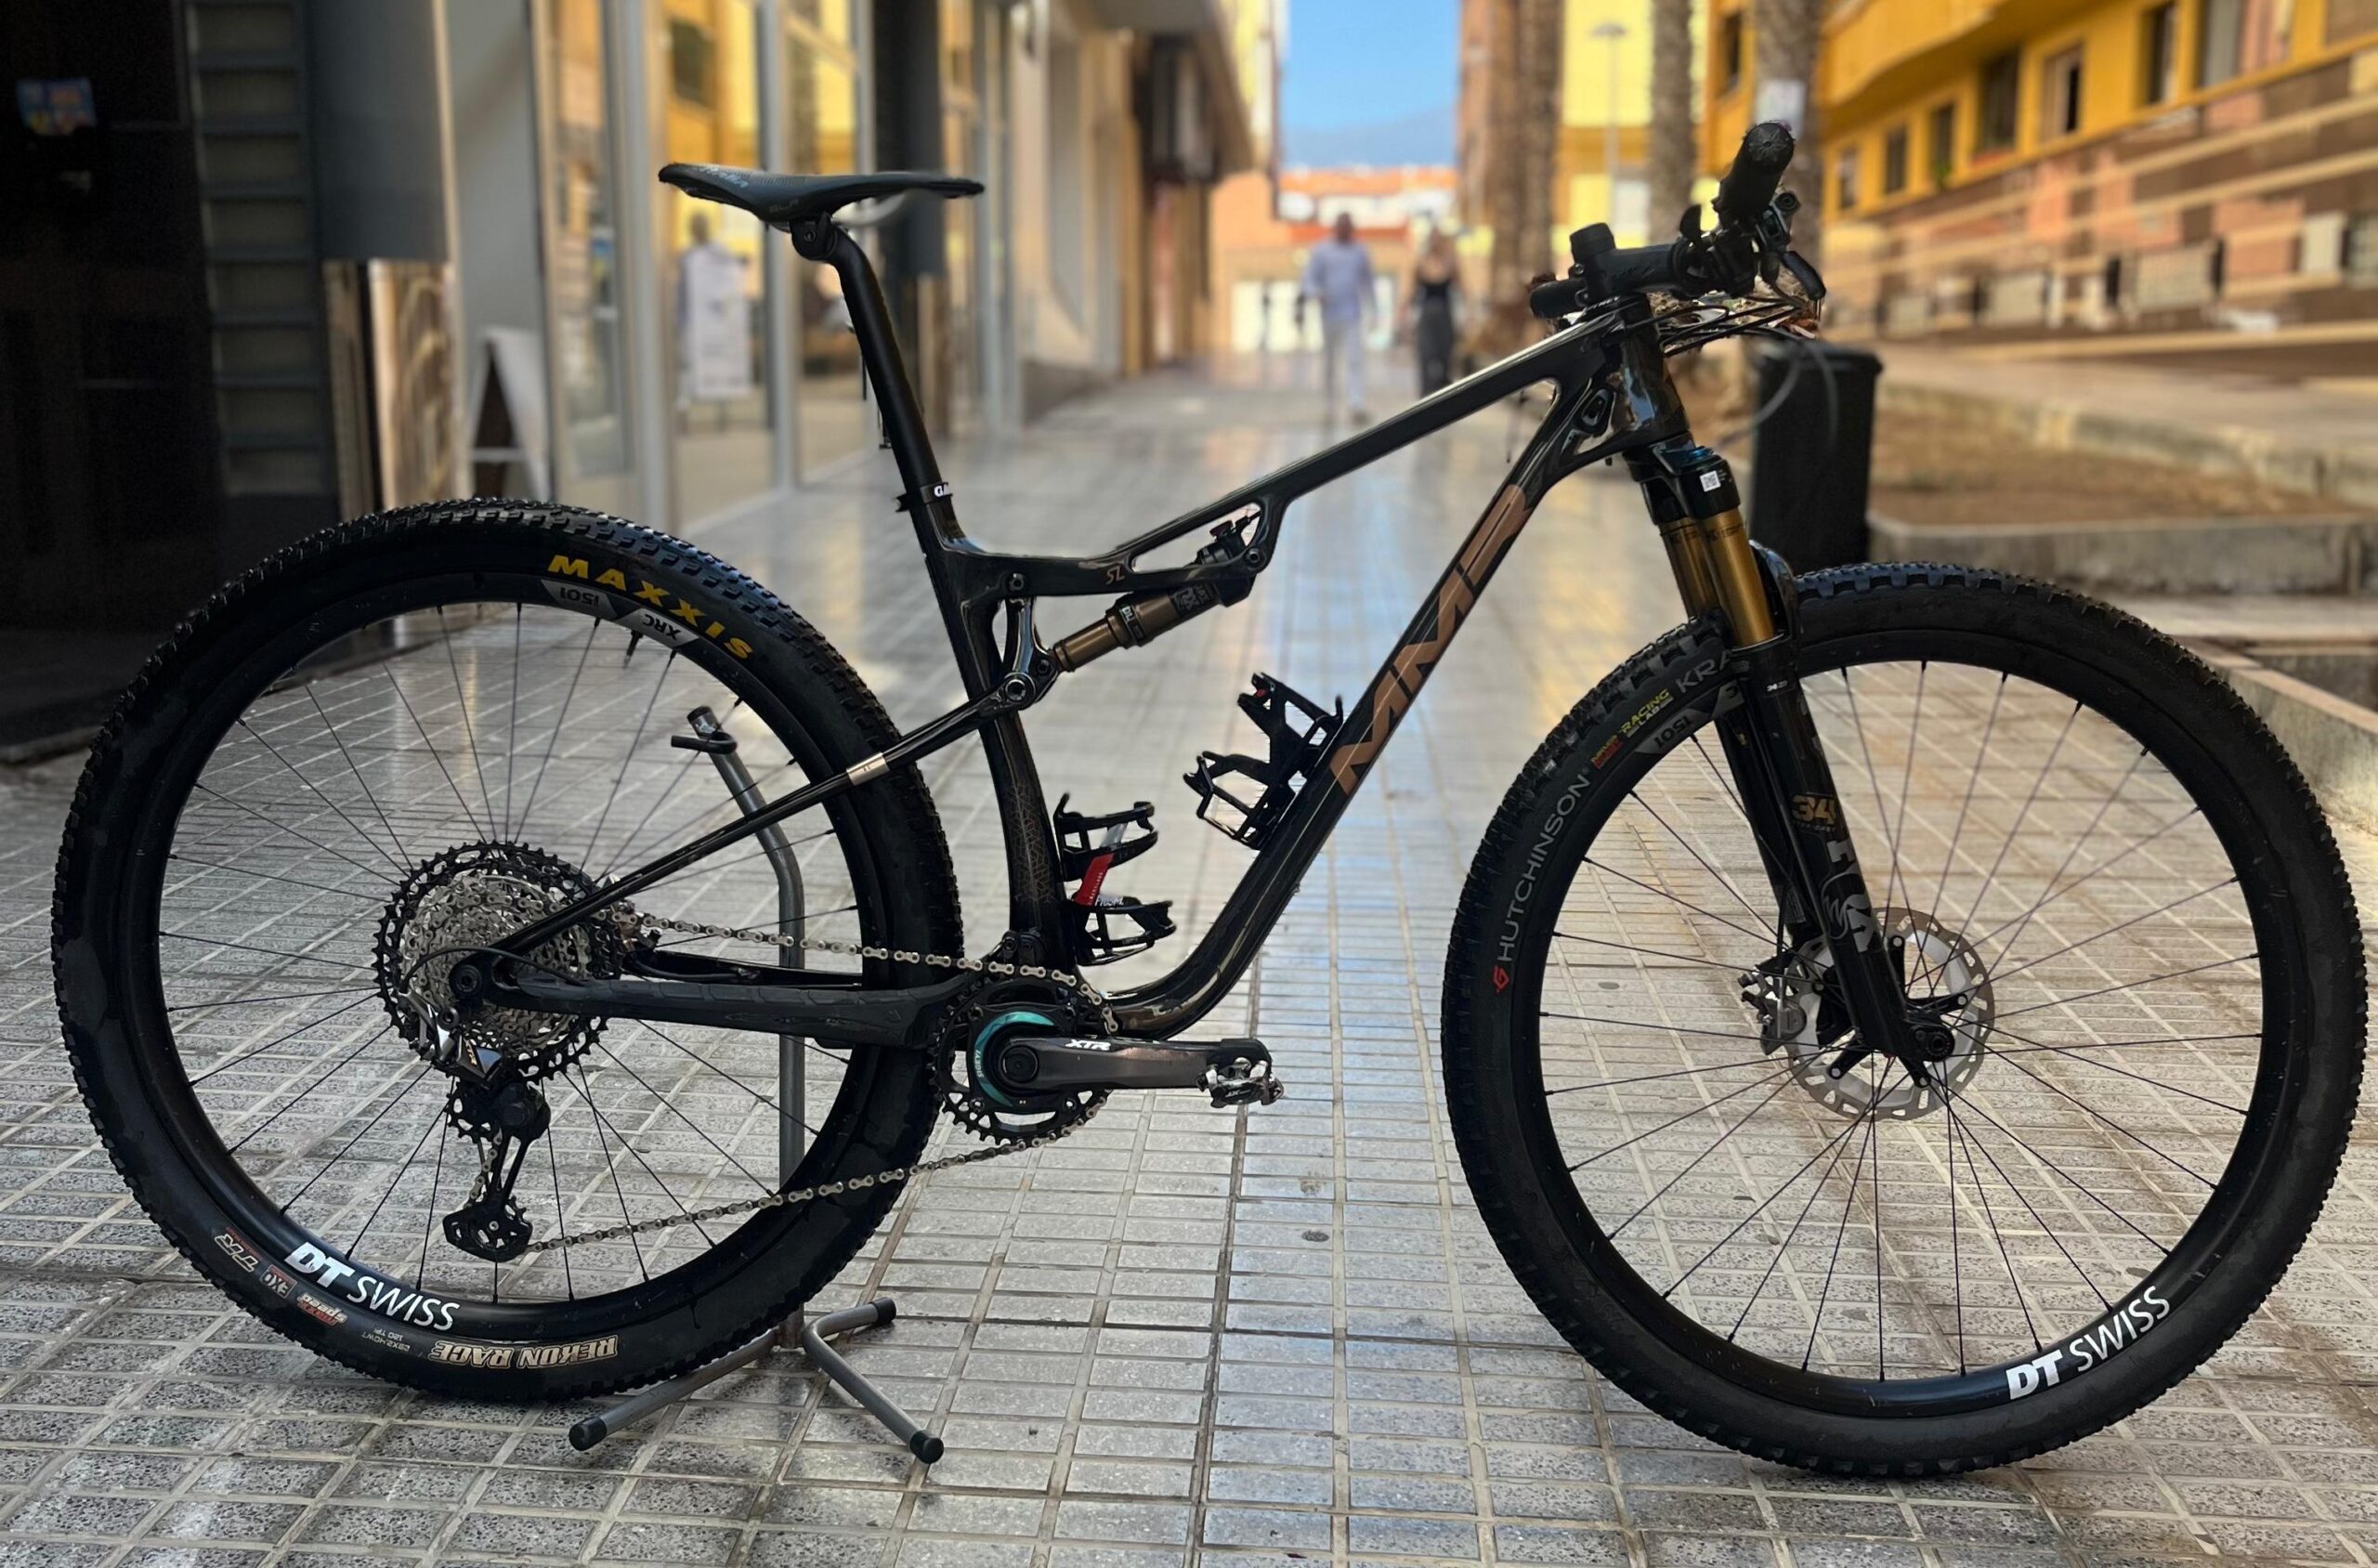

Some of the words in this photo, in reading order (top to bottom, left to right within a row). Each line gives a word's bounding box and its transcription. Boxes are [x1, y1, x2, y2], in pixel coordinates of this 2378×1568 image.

[547, 555, 753, 660] MAXXIS
[560, 587, 599, 608] 1501
[643, 614, 681, 641] XRC
[1329, 483, 1531, 796] MMR
[1620, 687, 1671, 733] RACING
[1497, 775, 1592, 961] HUTCHINSON
[1065, 1039, 1111, 1052] XTR
[214, 1233, 258, 1273] TR
[262, 1271, 293, 1297] EXO
[283, 1241, 357, 1289] DT
[347, 1274, 461, 1332] SWISS
[428, 1339, 512, 1368] RACE
[517, 1335, 619, 1368] REKON
[2006, 1350, 2063, 1401] DT
[2070, 1286, 2172, 1373] SWISS
